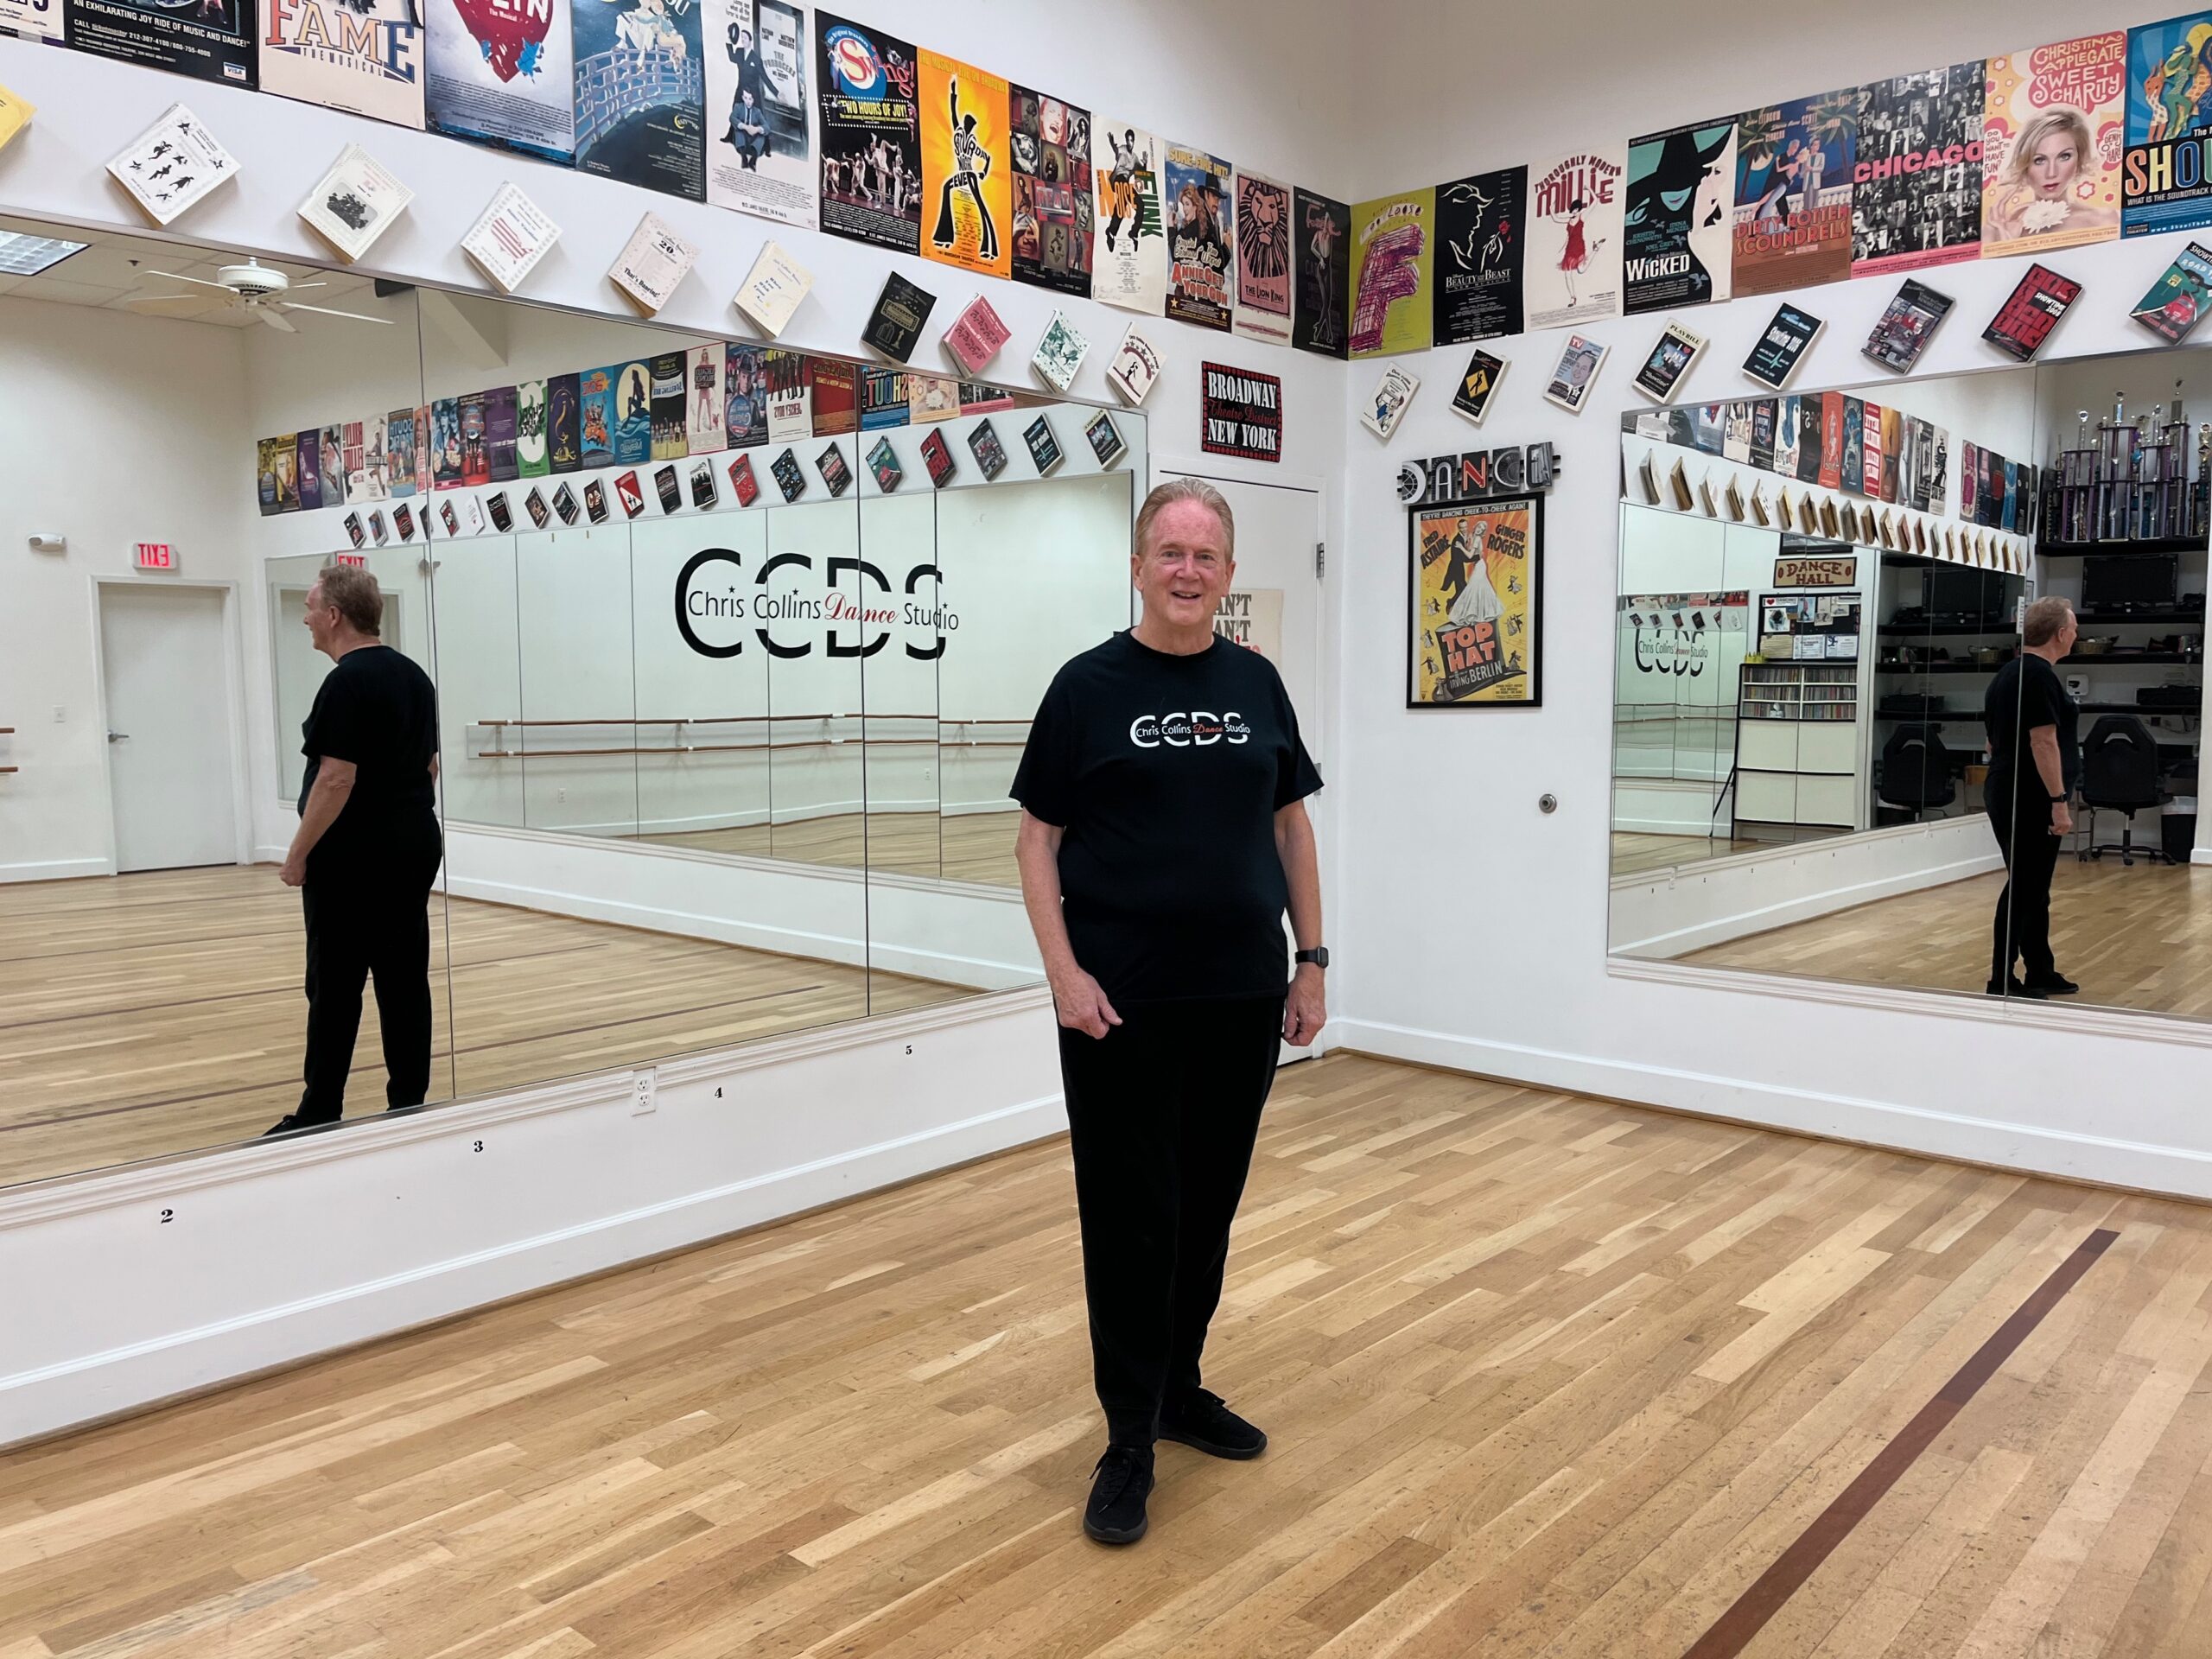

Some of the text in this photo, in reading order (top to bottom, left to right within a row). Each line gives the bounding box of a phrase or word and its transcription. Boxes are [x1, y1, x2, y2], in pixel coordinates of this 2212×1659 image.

[74, 19, 90, 29] CALL
[86, 0, 137, 21] EXHILARATING
[138, 13, 152, 24] JOY
[155, 16, 170, 29] RIDE
[172, 22, 181, 31] OF
[183, 25, 205, 37] MUSIC
[207, 29, 221, 41] AND
[489, 8, 499, 16] The
[499, 9, 518, 22] Musical
[265, 0, 415, 84] FAME
[2033, 34, 2124, 65] CHRISTINA
[303, 48, 382, 76] THE MUSICAL
[2036, 41, 2123, 74] APPLEGATE
[839, 38, 915, 99] Swing!
[2032, 63, 2114, 105] SWEET
[2050, 72, 2120, 114] CHARITY
[859, 101, 882, 116] HOURS
[882, 103, 891, 116] OF
[1986, 136, 2000, 148] YOU
[2194, 128, 2207, 137] The
[1985, 150, 2005, 162] HAVE
[1986, 142, 2004, 152] WANT
[1853, 140, 1985, 184] CHICAGO
[1984, 159, 2002, 176] FUN?
[1535, 155, 1621, 194] THOROUGHLY MODERN
[2127, 197, 2145, 206] WHAT
[2167, 187, 2209, 200] SOUNDTRACK
[1736, 203, 1849, 238] DIRTY ROTTEN
[1735, 220, 1847, 257] SCOUNDRELS
[624, 267, 639, 283] That's
[1172, 262, 1224, 288] ANNIE GET
[2181, 258, 2207, 272] ROAD
[1446, 269, 1511, 288] BEAUTY BEAST
[1183, 280, 1228, 306] YOUR GUN
[1245, 285, 1284, 302] THE LION KING
[2034, 291, 2067, 311] SHOWTIME
[1572, 338, 1584, 348] TV
[1669, 324, 1700, 345] PLAYBILL
[1208, 371, 1276, 409] BROADWAY
[1207, 418, 1277, 451] NEW YORK
[1402, 441, 1554, 505] DANCE
[1442, 509, 1463, 518] DANCING
[1464, 505, 1507, 516] CHEEK-TO-CHEEK
[1508, 502, 1527, 511] AGAIN!
[1422, 531, 1439, 548] FRED
[1496, 524, 1526, 543] GINGER
[1420, 534, 1452, 569] ASTAIRE
[1486, 533, 1525, 560] ROGERS
[1786, 561, 1843, 577] DANCE
[1796, 573, 1834, 585] HALL
[675, 547, 946, 661] CCDS
[688, 585, 959, 631] Chris Collins Dance Studio
[1213, 594, 1252, 617] AN'T
[1214, 620, 1251, 642] AN'T
[1441, 621, 1494, 652] TOP
[1447, 640, 1496, 672] HAT
[1638, 639, 1654, 653] Chris
[1656, 639, 1675, 655] Collins
[1449, 660, 1503, 690] IRVING BERLIN
[1135, 722, 1251, 738] Chris Collins Dance Studio
[906, 1045, 912, 1055] 5
[715, 1087, 723, 1098] 4
[474, 1141, 484, 1153] 3
[161, 1209, 174, 1224] 2
